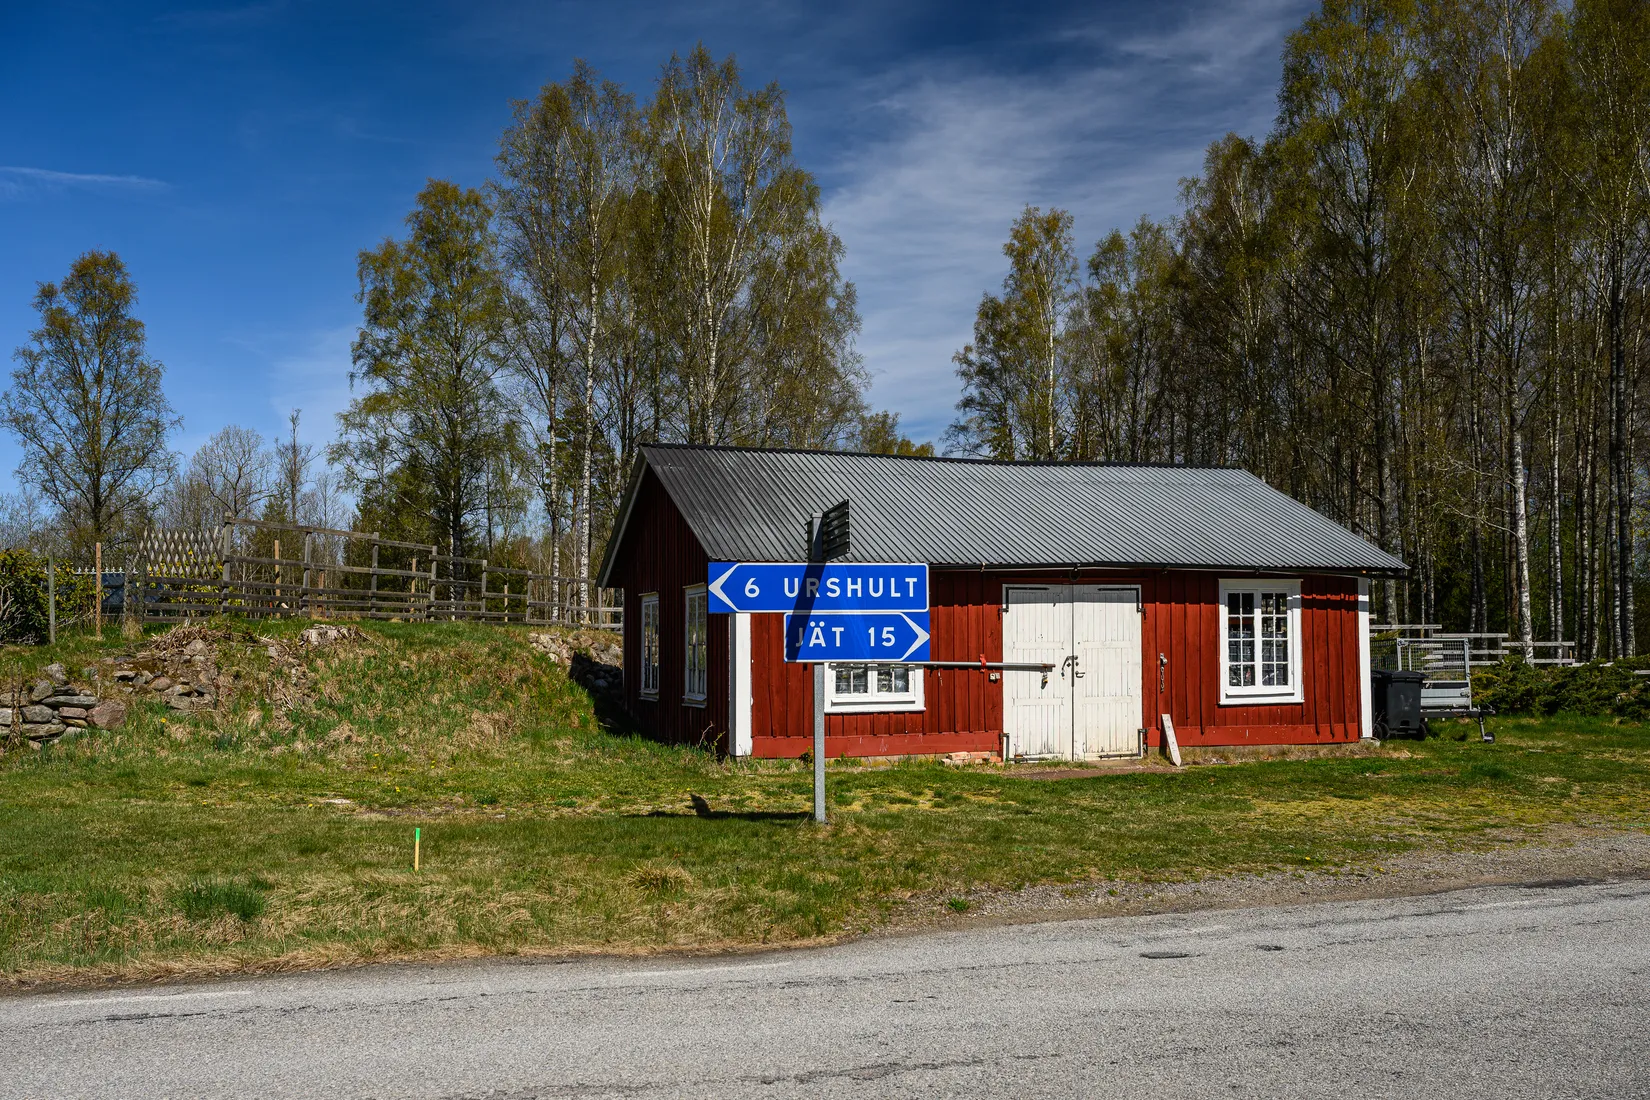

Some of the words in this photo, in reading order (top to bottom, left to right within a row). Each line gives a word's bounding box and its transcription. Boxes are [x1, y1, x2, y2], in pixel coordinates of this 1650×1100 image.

[744, 577, 760, 598] 6
[783, 577, 918, 598] URSHULT
[795, 621, 845, 648] JÄT
[868, 626, 896, 647] 15
